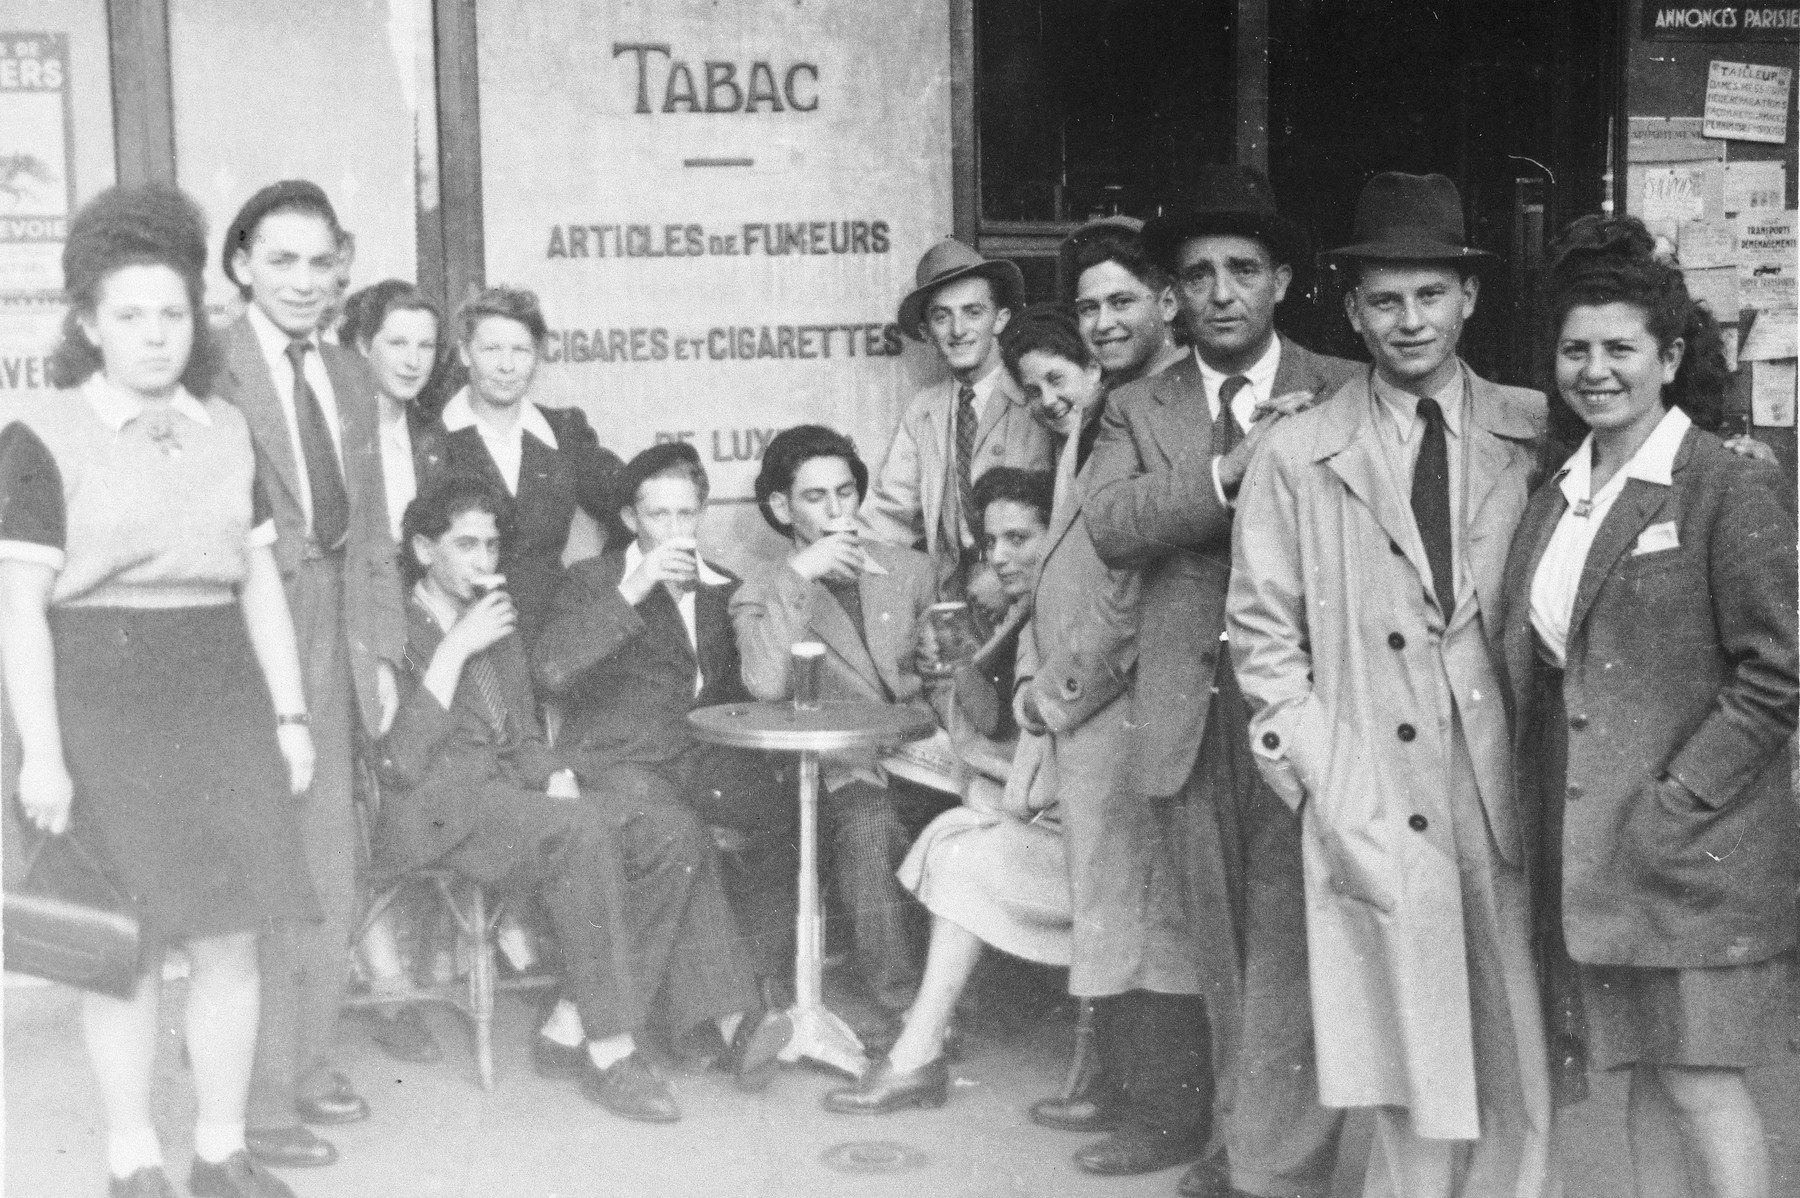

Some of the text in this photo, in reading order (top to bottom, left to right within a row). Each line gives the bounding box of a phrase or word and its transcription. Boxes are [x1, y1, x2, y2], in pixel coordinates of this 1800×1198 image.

[1655, 8, 1737, 28] ANNONCES
[612, 42, 820, 114] TABAC
[547, 221, 890, 258] ARTICLES DE FUMEURS
[1747, 226, 1790, 235] TRANSPORTS
[545, 323, 903, 363] CIGARES ET CIGARETTES
[712, 428, 784, 462] LUX
